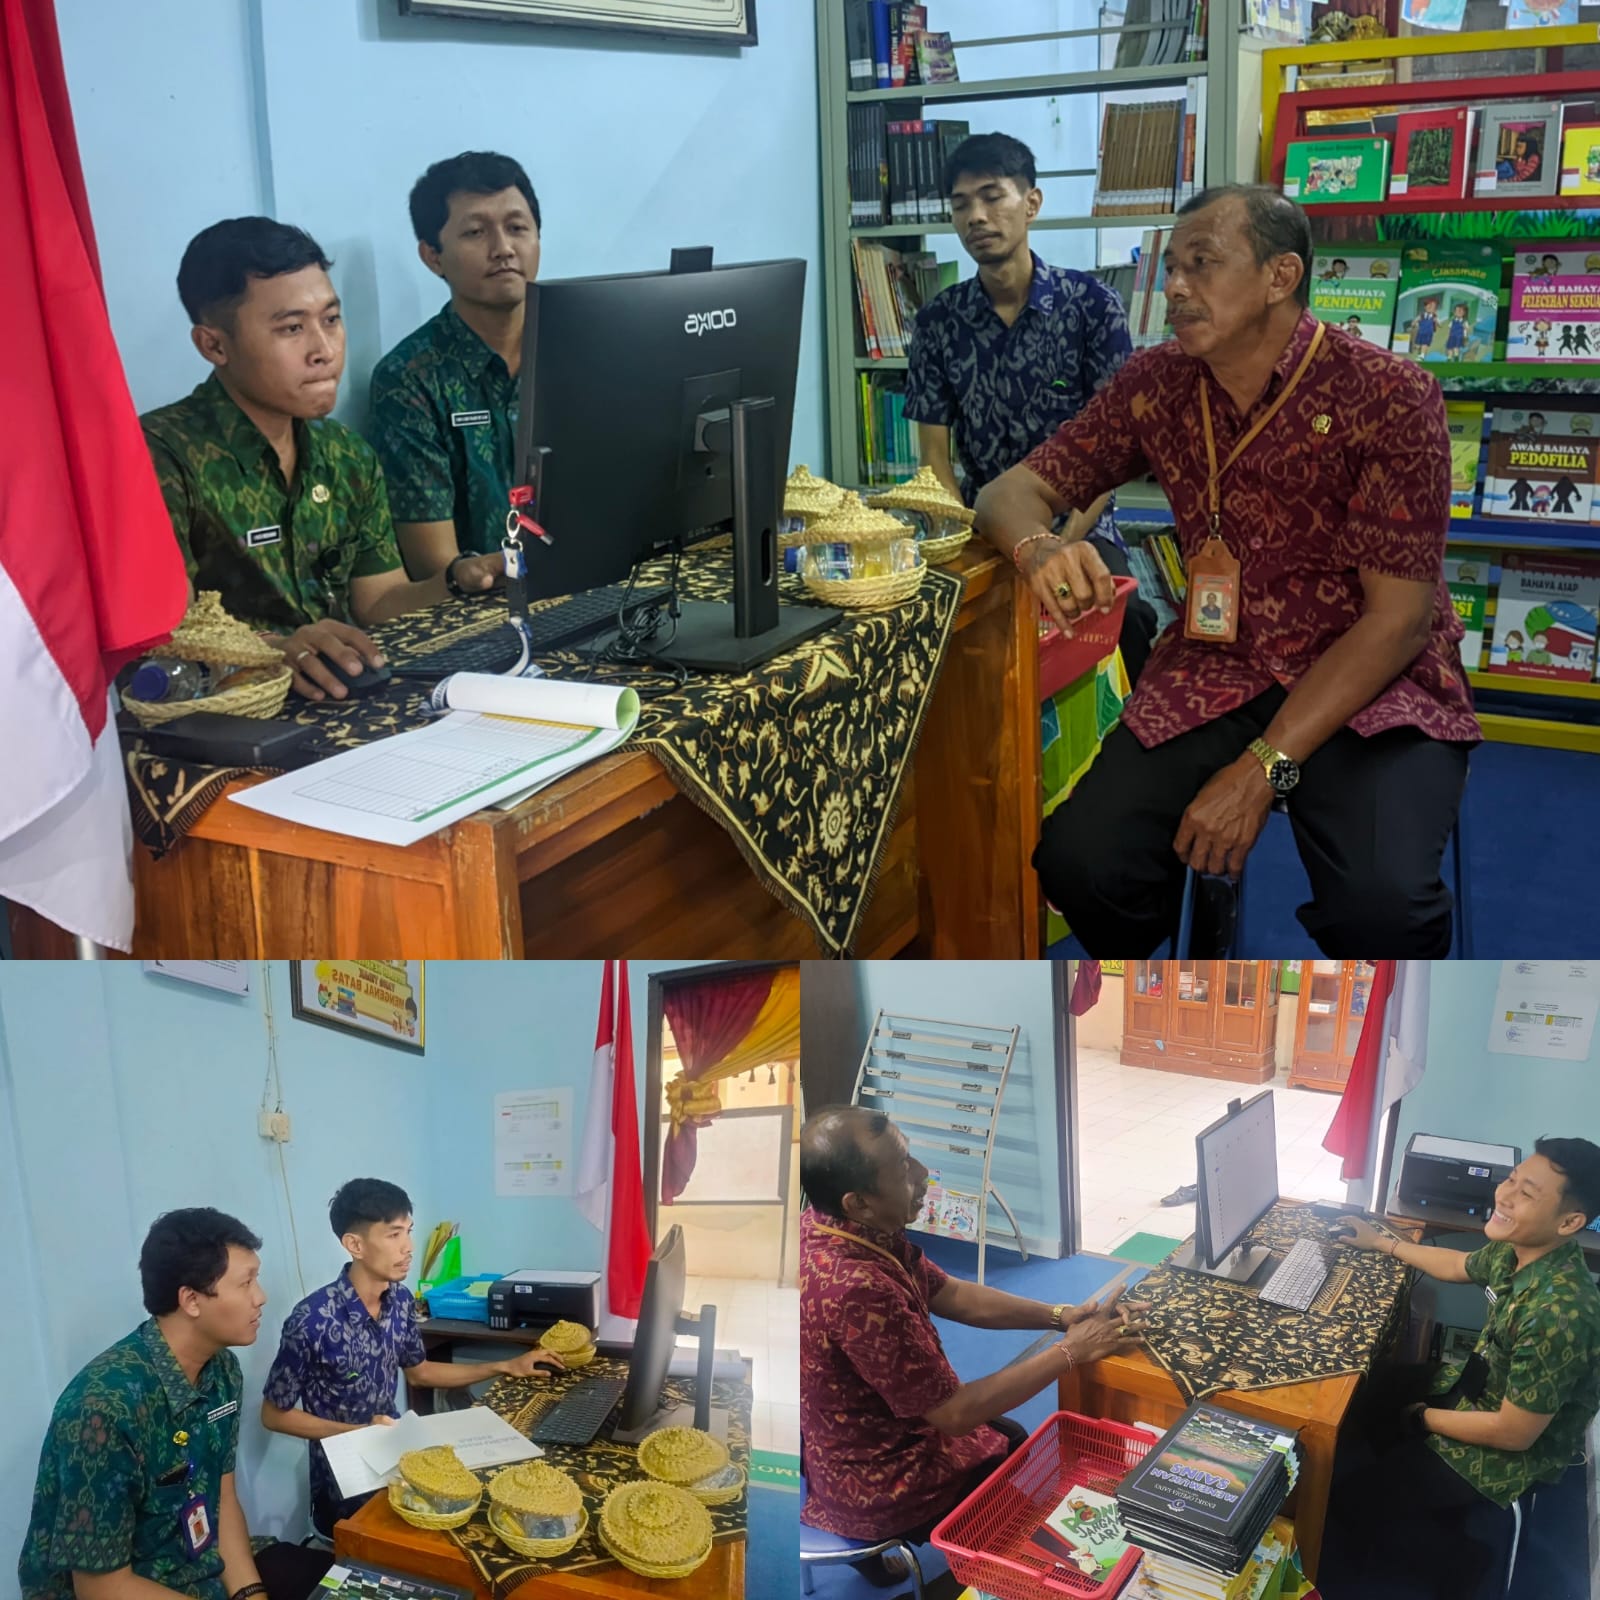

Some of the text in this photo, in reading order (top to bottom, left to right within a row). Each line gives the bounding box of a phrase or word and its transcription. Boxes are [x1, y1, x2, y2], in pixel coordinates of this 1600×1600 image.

[1314, 288, 1386, 297] AWAS BAHAYA
[1523, 285, 1556, 293] AWAS
[1314, 295, 1384, 310] PENIPUAN
[1521, 294, 1569, 308] PELECEHAN
[1510, 443, 1590, 455] AWAS BAHAYA
[1510, 452, 1588, 469] PEDOFILIA
[1521, 578, 1556, 590] BAHAYA
[1170, 1463, 1231, 1491] SAINS
[1149, 1467, 1239, 1503] MENEMUKAN
[1154, 1483, 1172, 1494] SAINS
[1172, 1489, 1217, 1509] ENSIKLOPEDIA
[1090, 1524, 1120, 1545] LARI
